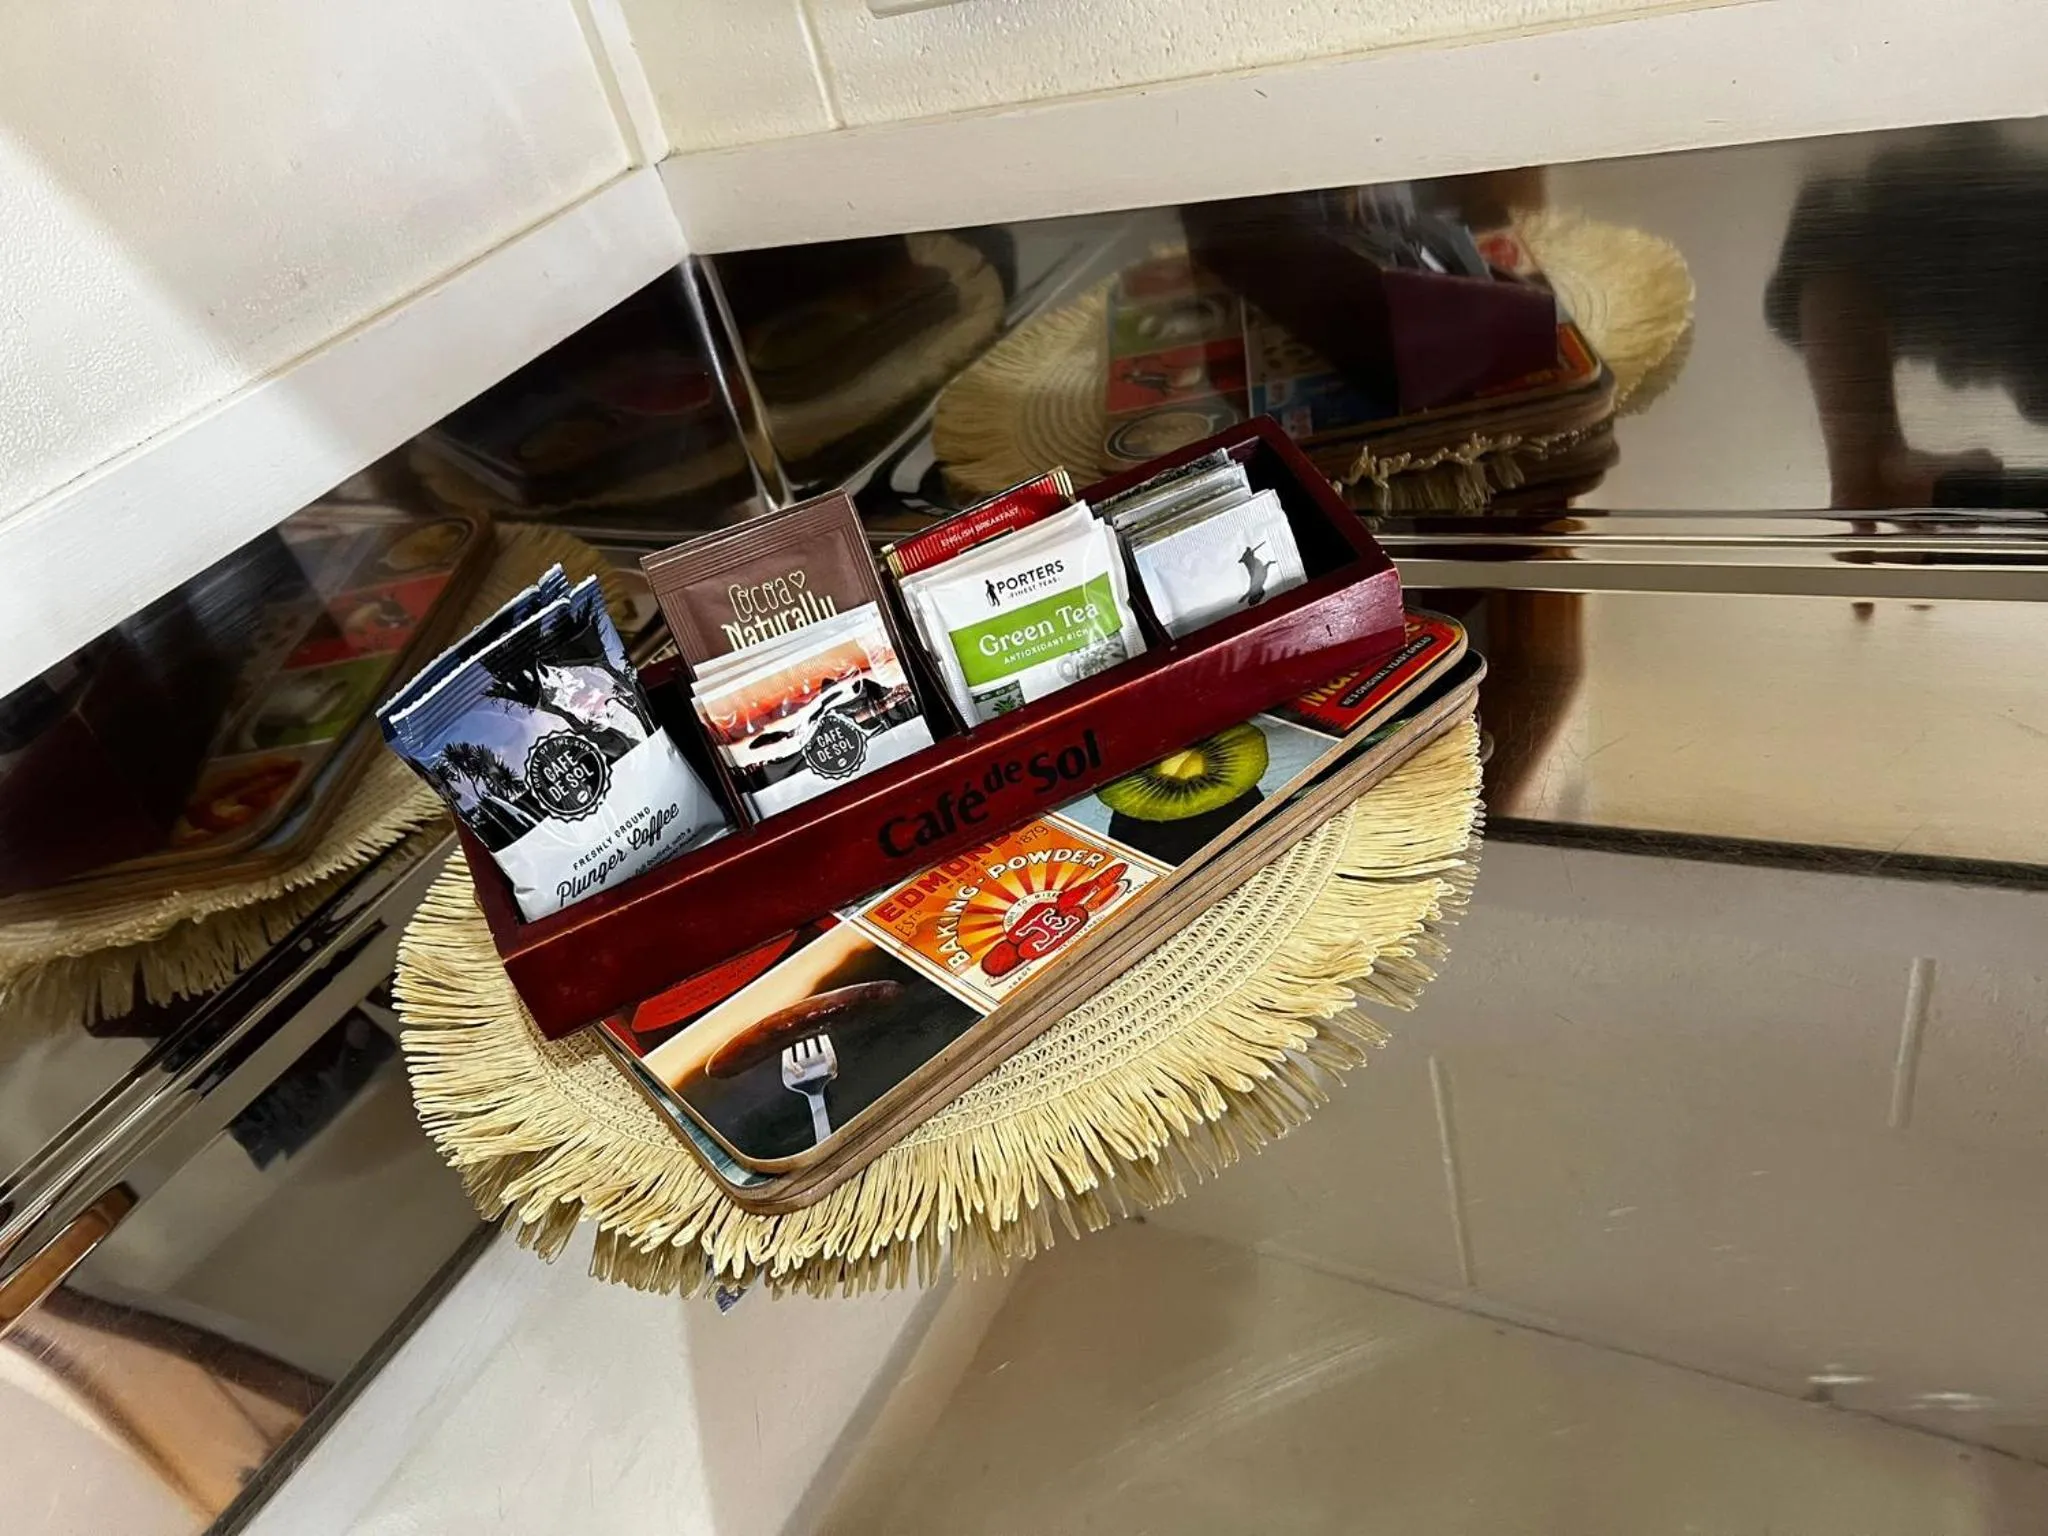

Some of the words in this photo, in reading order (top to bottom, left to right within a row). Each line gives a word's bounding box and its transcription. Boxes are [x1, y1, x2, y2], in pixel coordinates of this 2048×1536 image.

[940, 527, 976, 547] ENGLISH
[974, 505, 1019, 533] BREAKFAST
[996, 560, 1065, 594] PORTERS
[1011, 586, 1036, 598] FINEST
[1038, 577, 1058, 588] TEAS
[728, 577, 796, 624] Cocoa
[978, 619, 1055, 656] Green
[1055, 602, 1099, 628] Tea
[1004, 636, 1065, 665] ANTIOXIDANT
[1066, 628, 1089, 641] RICH
[816, 727, 845, 748] CAFE
[816, 746, 834, 763] DE
[832, 737, 856, 756] SOL
[543, 750, 579, 783] CAFE
[548, 780, 570, 802] DE
[565, 763, 595, 789] SOL
[878, 780, 990, 859] Café
[983, 760, 1024, 794] de
[1028, 728, 1102, 795] Sol
[556, 848, 628, 908] Plunger
[627, 802, 680, 851] Coffee
[573, 837, 614, 871] FRESHLY
[614, 805, 652, 838] GROUND
[1016, 825, 1050, 847] 1879
[937, 884, 981, 972] BAKING
[987, 848, 1106, 879] POWDER
